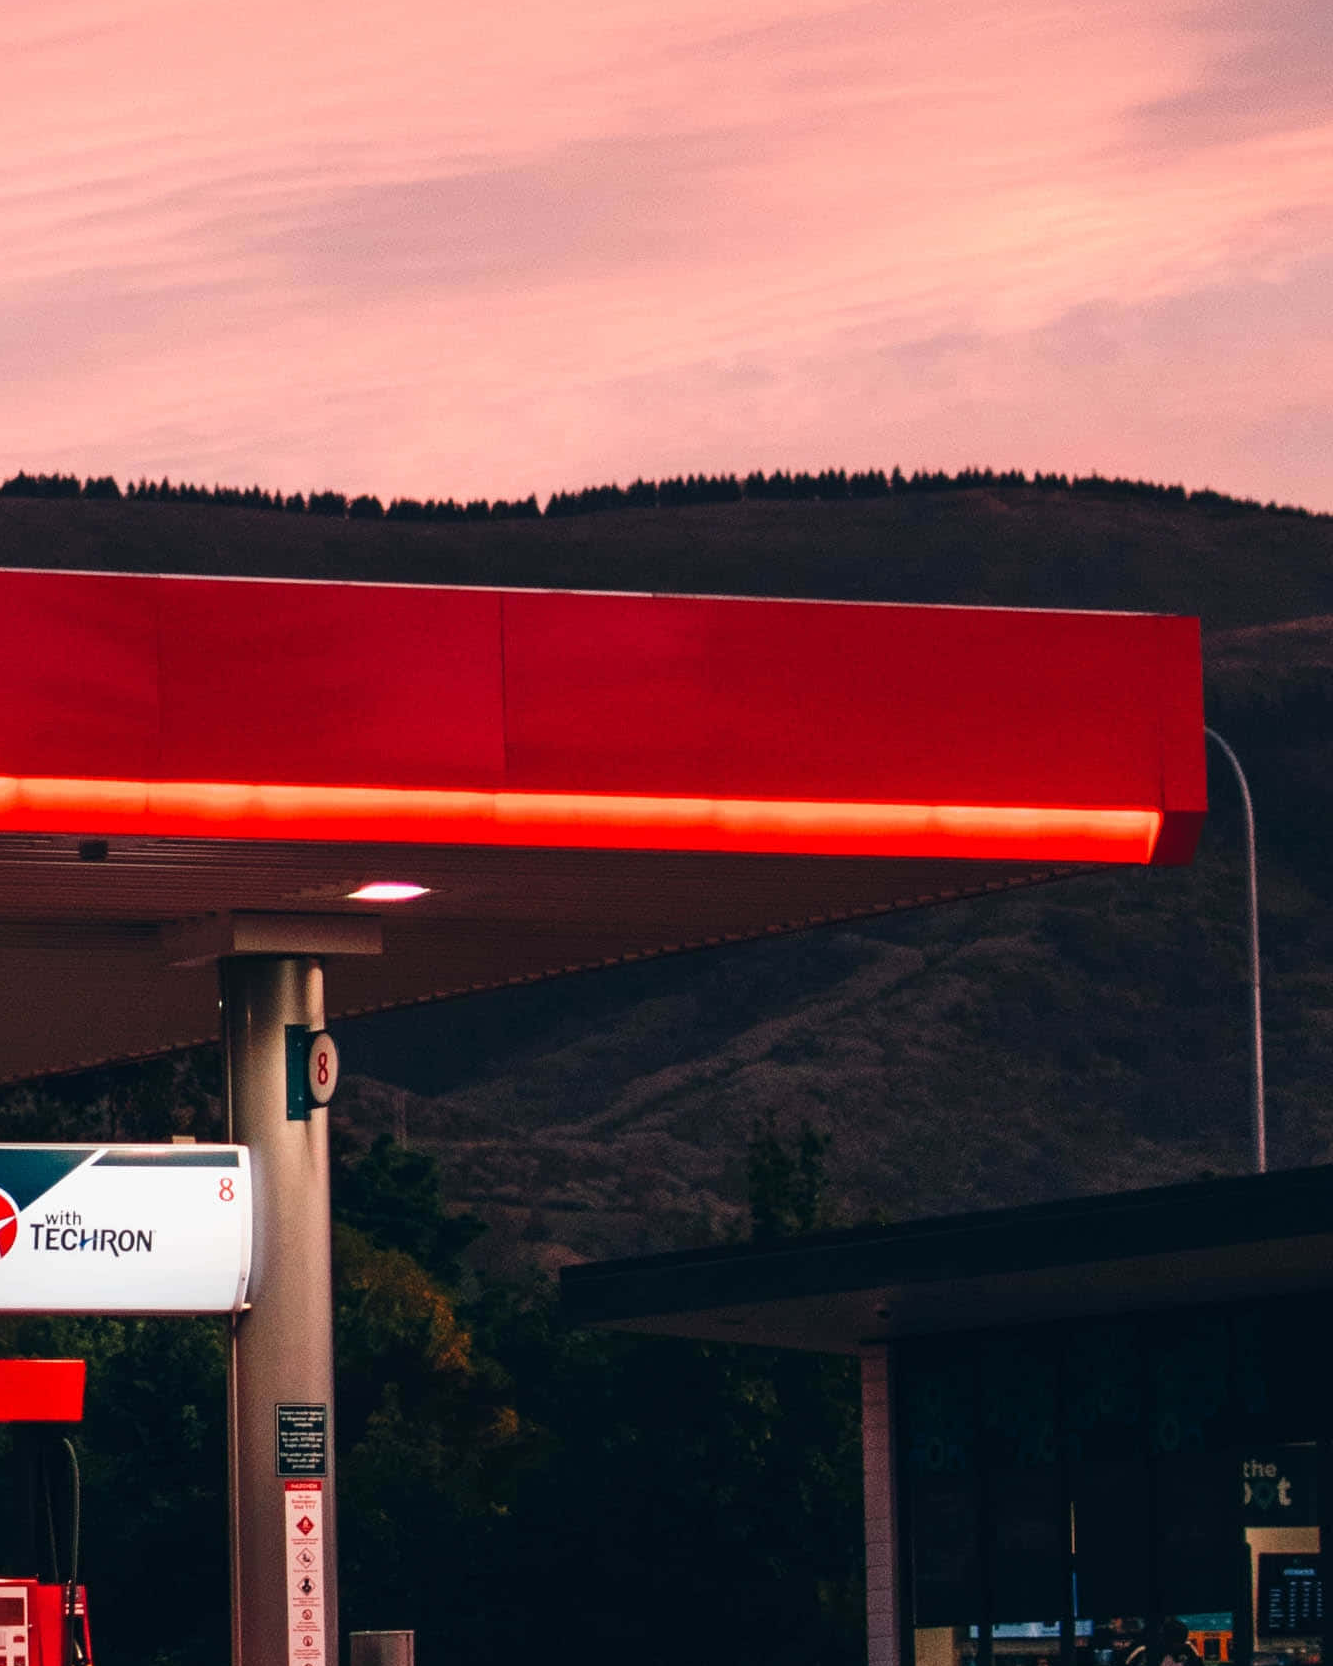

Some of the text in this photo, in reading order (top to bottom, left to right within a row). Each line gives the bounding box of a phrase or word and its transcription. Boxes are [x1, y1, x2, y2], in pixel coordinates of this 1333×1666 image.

[317, 1051, 329, 1085] 8
[218, 1177, 235, 1202] 8
[45, 1210, 82, 1226] with
[30, 1223, 153, 1257] TECHRON
